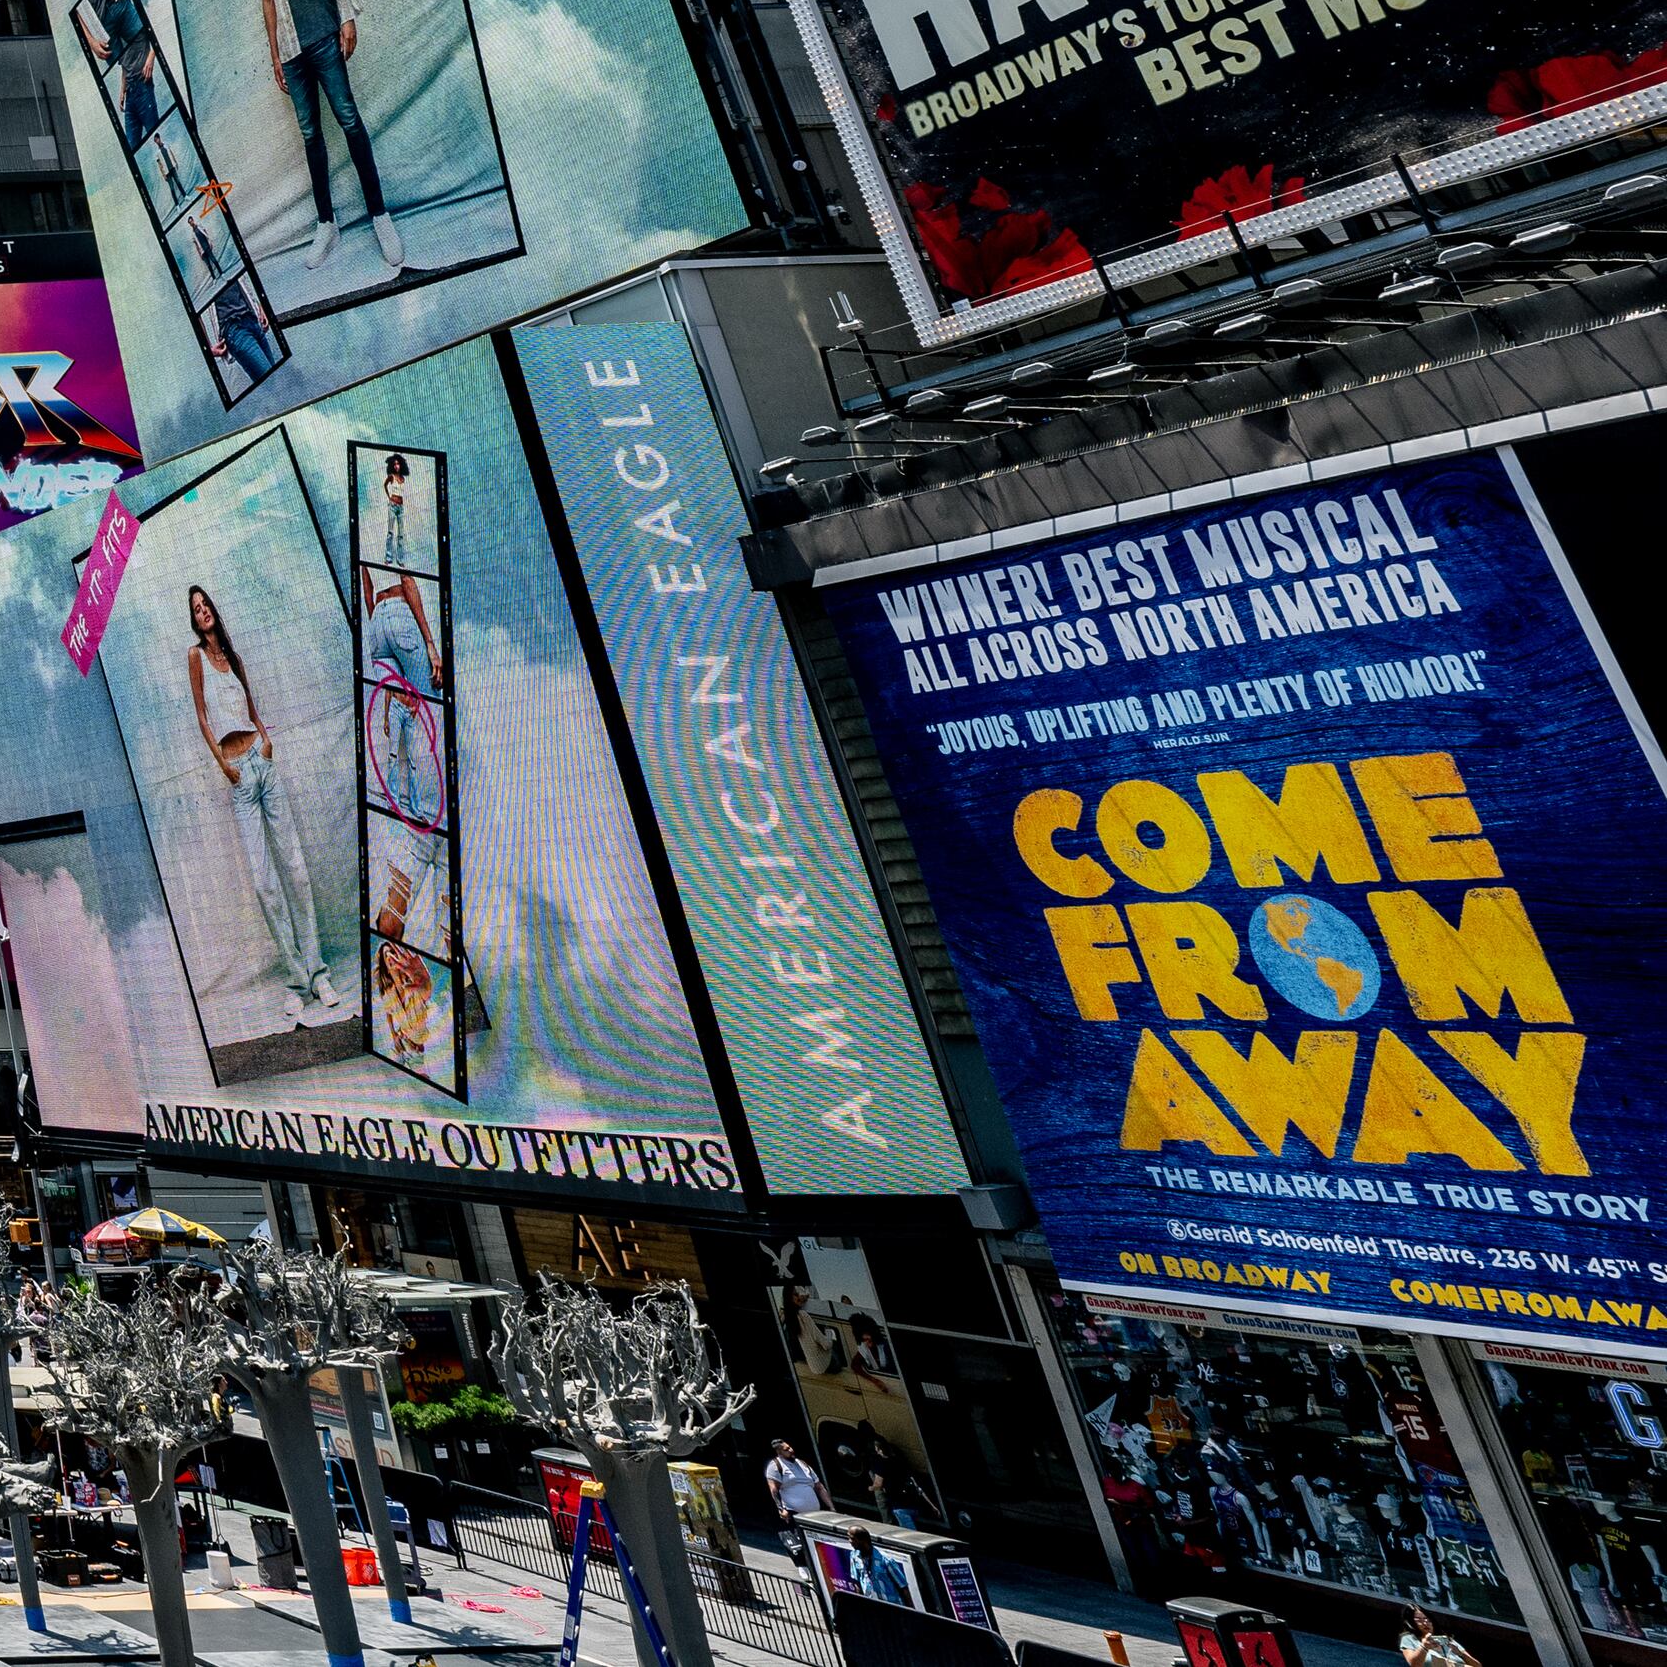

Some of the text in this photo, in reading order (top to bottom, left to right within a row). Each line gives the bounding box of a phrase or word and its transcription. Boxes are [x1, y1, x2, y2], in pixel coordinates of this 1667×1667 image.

[70, 509, 126, 656] THE FITS
[877, 488, 1439, 645] WINNER! BEST MUSICAL
[902, 559, 1462, 694] ALL ACROSS NORTH AMERICA
[1024, 666, 1353, 745] UPLIFTING AND PLENTY OF
[1152, 731, 1230, 751] HERALD SUN
[584, 356, 890, 1152] AMERICAN EAGLE
[1012, 751, 1502, 898] COME
[1119, 1027, 1590, 1177] AWAY
[145, 1104, 740, 1195] AMERICAN EAGLE OUTFITTERS
[1145, 1165, 1649, 1223] THE REMARKABLE TRUE STORY
[1119, 1251, 1331, 1295] ON BROADWAY
[1187, 1223, 1253, 1246] Gerald
[1257, 1229, 1380, 1258] Schoenfeld
[1383, 1239, 1484, 1270] Theatre,
[1487, 1249, 1537, 1271] 236
[1545, 1255, 1580, 1276] W.
[1405, 1414, 1430, 1441] 15
